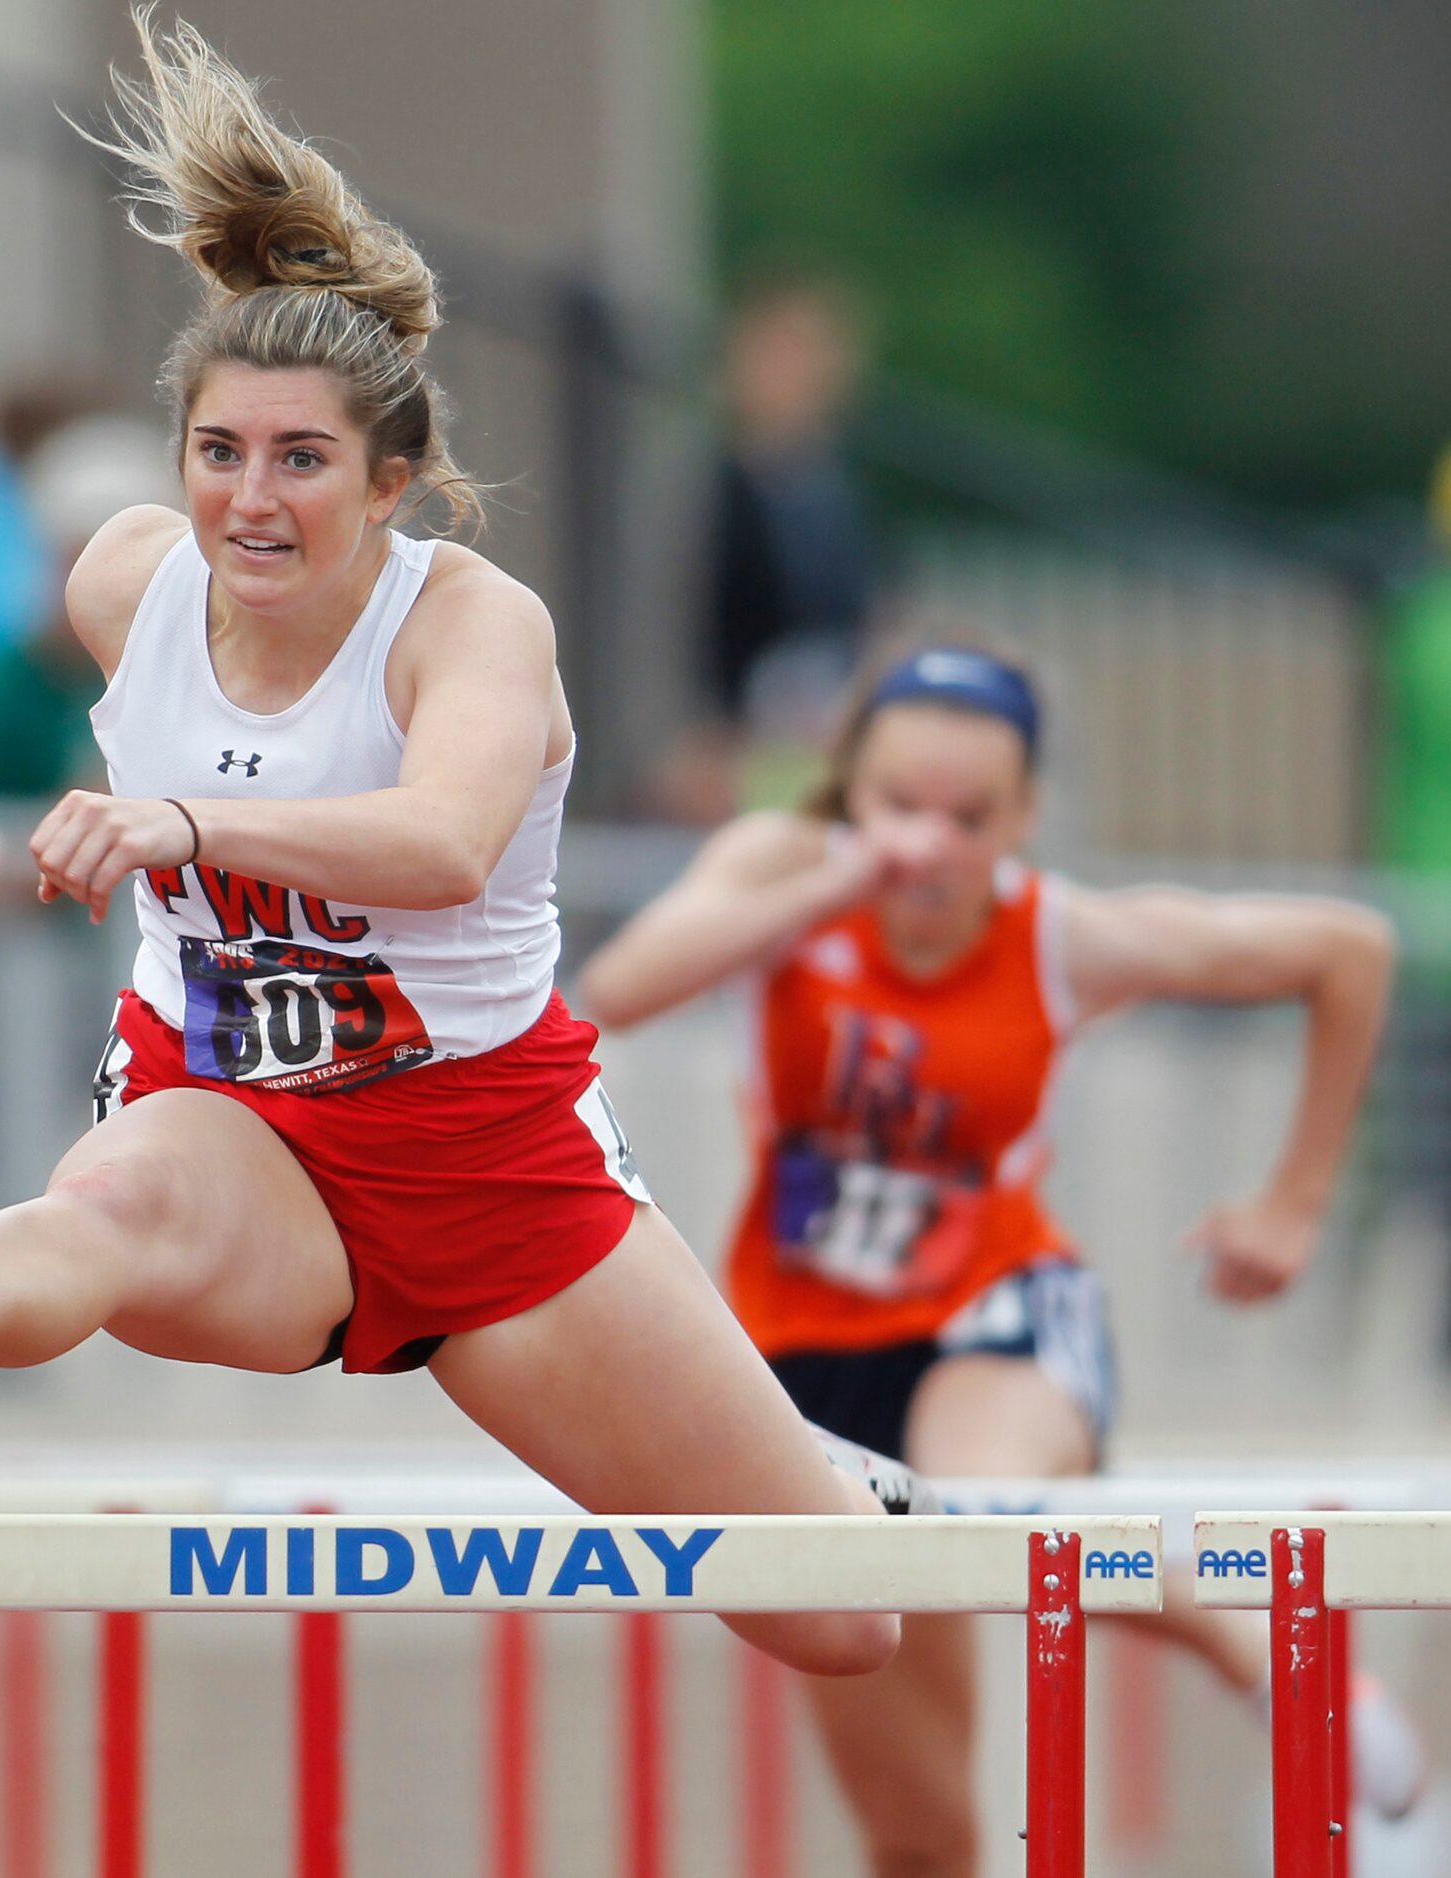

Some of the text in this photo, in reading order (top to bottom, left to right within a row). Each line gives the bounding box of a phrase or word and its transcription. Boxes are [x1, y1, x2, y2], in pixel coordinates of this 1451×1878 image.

[212, 975, 386, 1077] 609
[315, 1059, 358, 1081] TEXAS
[169, 1527, 725, 1597] MIDWAY
